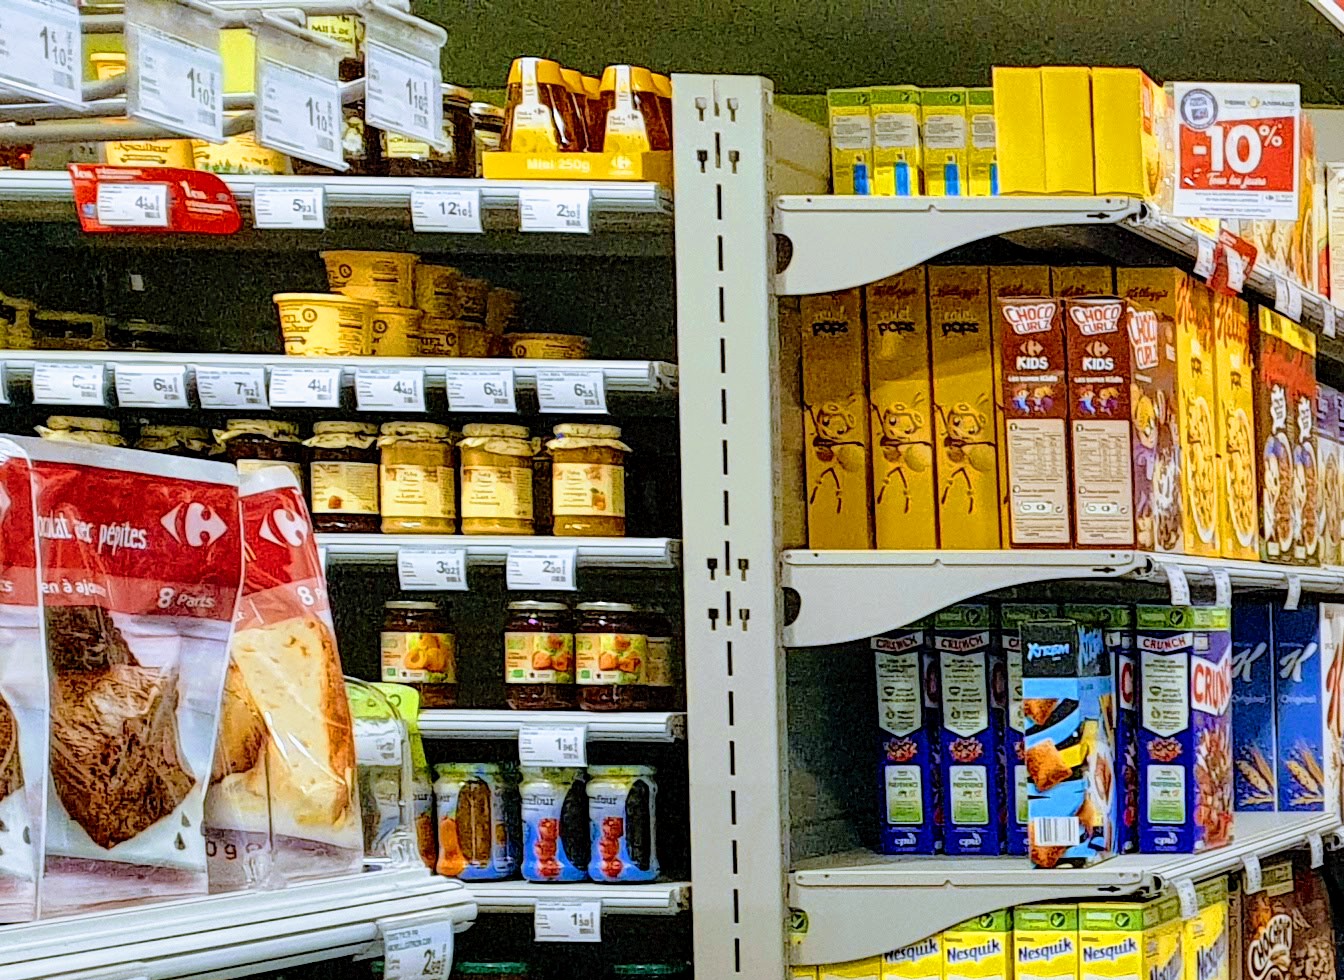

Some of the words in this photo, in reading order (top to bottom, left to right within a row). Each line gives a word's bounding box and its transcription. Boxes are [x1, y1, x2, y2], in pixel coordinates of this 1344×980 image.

[1192, 124, 1283, 174] -10%
[1004, 305, 1055, 322] CHOCO
[1071, 305, 1121, 322] CHOCO
[1015, 319, 1053, 334] CURLZ
[1081, 319, 1118, 334] CURLZ
[1016, 357, 1049, 371] KIDS
[1082, 357, 1114, 371] KIDS
[97, 520, 148, 555] pépites
[158, 587, 175, 609] 8
[176, 593, 216, 609] Parts
[296, 585, 315, 606] 8
[1142, 637, 1187, 649] CRUNCH
[946, 938, 1001, 962] Nesquik
[1018, 938, 1073, 962] Nesquik
[1083, 939, 1137, 962] Nesquik
